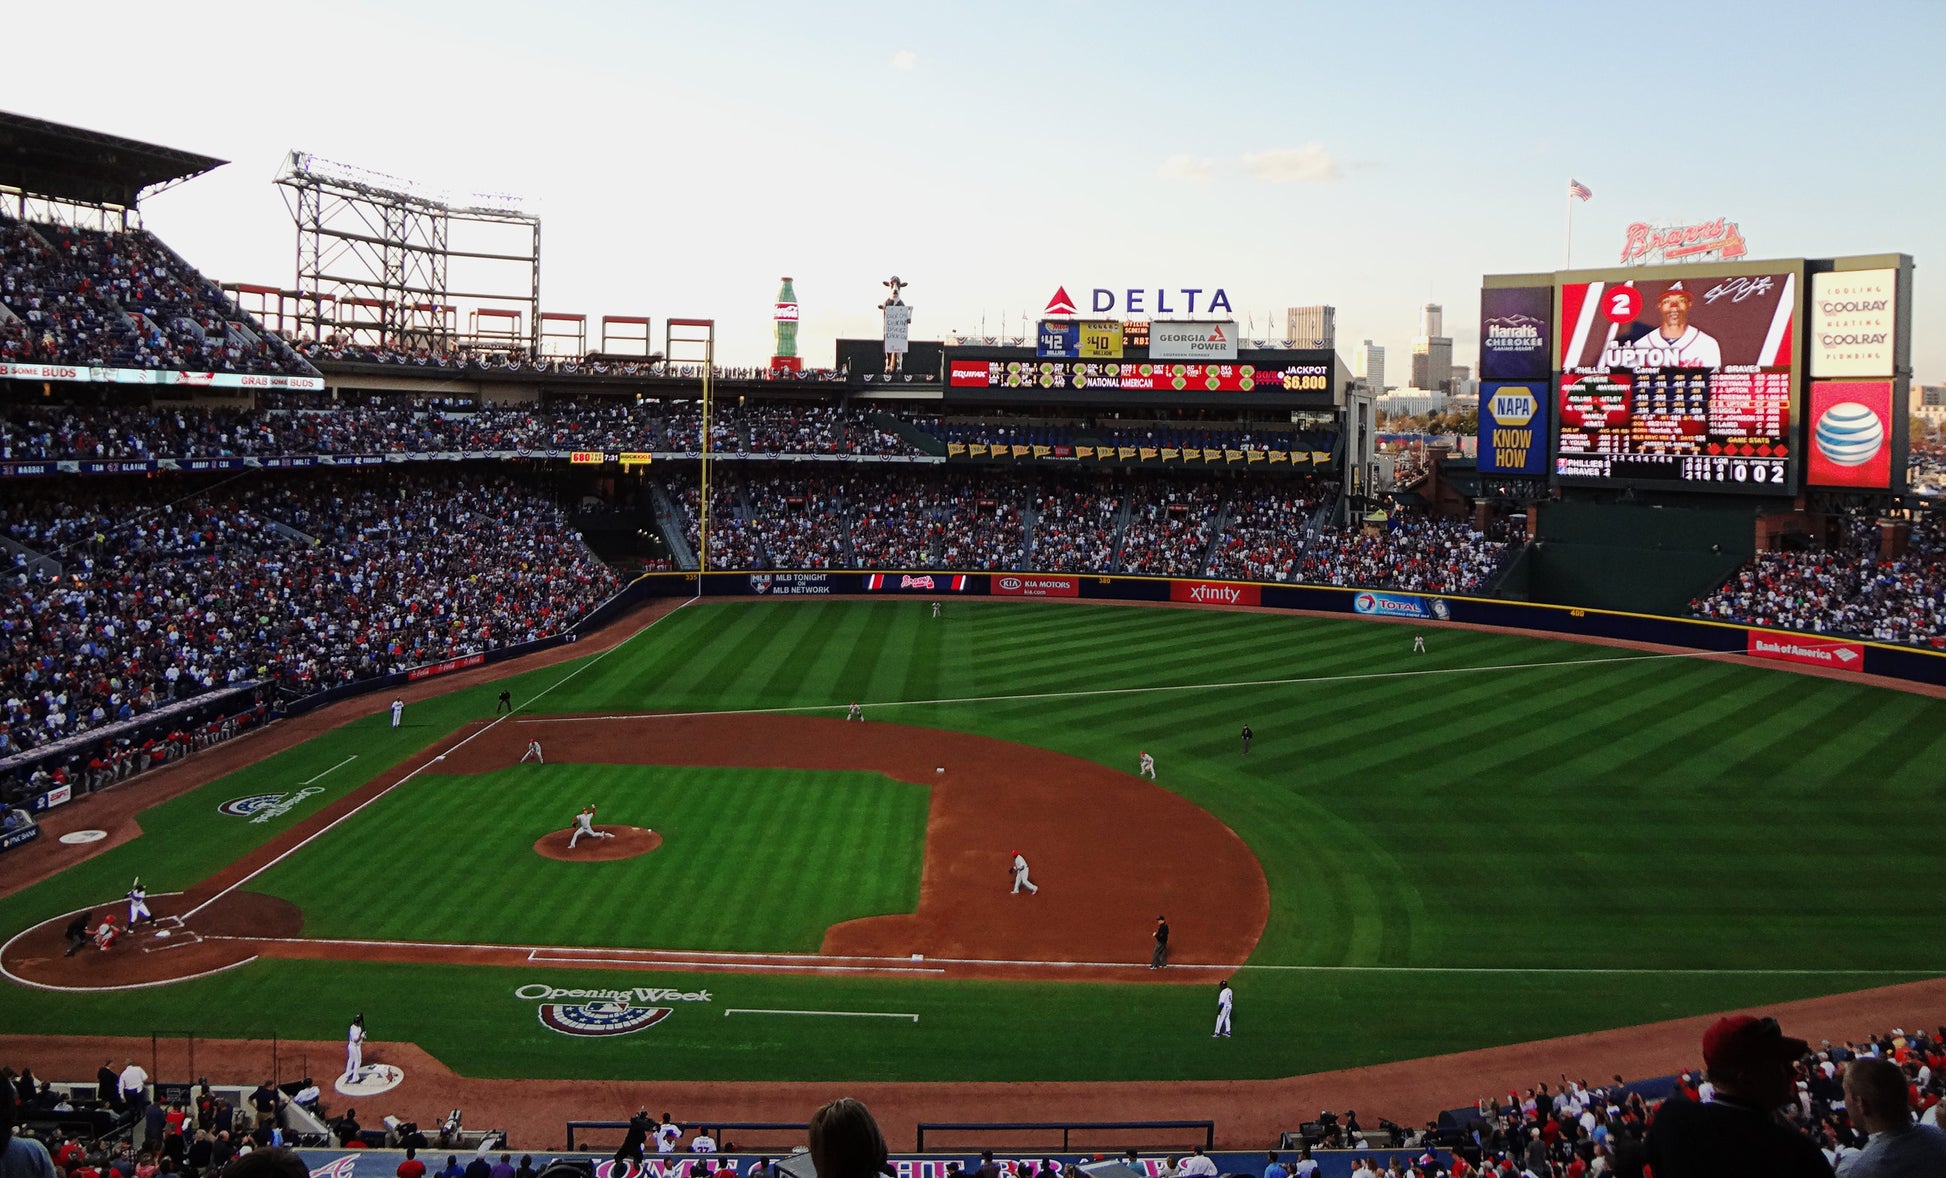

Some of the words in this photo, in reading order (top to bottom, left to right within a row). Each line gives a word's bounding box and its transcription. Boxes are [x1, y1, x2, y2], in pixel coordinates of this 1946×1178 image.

[1620, 217, 1726, 263] Braves
[1092, 289, 1233, 313] DELTA
[1611, 294, 1630, 315] 2
[1823, 300, 1888, 313] COOLRAY
[1041, 334, 1063, 350] $42
[1087, 336, 1109, 350] $40
[1122, 337, 1128, 345] 2
[1133, 337, 1150, 345] RBI
[1159, 334, 1206, 343] GEORGIA
[1484, 337, 1543, 347] CHEROKEE
[1823, 333, 1888, 345] COOLRAY
[1190, 343, 1227, 351] POWER
[1607, 348, 1681, 367] UPTON
[11, 366, 38, 375] SOME
[41, 367, 77, 378] BUDS
[952, 370, 987, 379] EQUIFAX
[1285, 366, 1327, 375] JACKPOT
[1575, 366, 1611, 374] PHILLIES
[1633, 367, 1660, 375] Career
[1725, 365, 1761, 374] BRAVES
[241, 376, 268, 386] GRAB
[290, 378, 314, 387] BUDS
[1087, 378, 1120, 388] NATIONAL
[1121, 378, 1153, 388] AMERICAN
[1284, 376, 1326, 390] $6,800
[1497, 397, 1530, 416] NAPA
[1493, 429, 1532, 449] KNOW
[573, 454, 591, 462] 680
[604, 454, 618, 462] 7:31
[1495, 449, 1527, 468] HOW
[1568, 459, 1604, 468] PHILLIES
[1567, 468, 1600, 476] BRAVES
[1604, 468, 1611, 477] 2
[1734, 465, 1747, 482] 0
[1754, 466, 1766, 483] 0
[1770, 466, 1784, 483] 2
[752, 574, 771, 582] MLB
[901, 575, 934, 588] Braves
[773, 586, 790, 594] MLB
[791, 586, 830, 594] NETWORK
[1039, 581, 1070, 589] MOTORS
[1190, 584, 1240, 603] xfinity
[1380, 600, 1421, 612] TOTAL
[1756, 640, 1780, 653] Bank
[1780, 646, 1792, 654] of
[1791, 646, 1832, 660] America
[514, 984, 634, 1002] Opening
[632, 988, 713, 1002] Week
